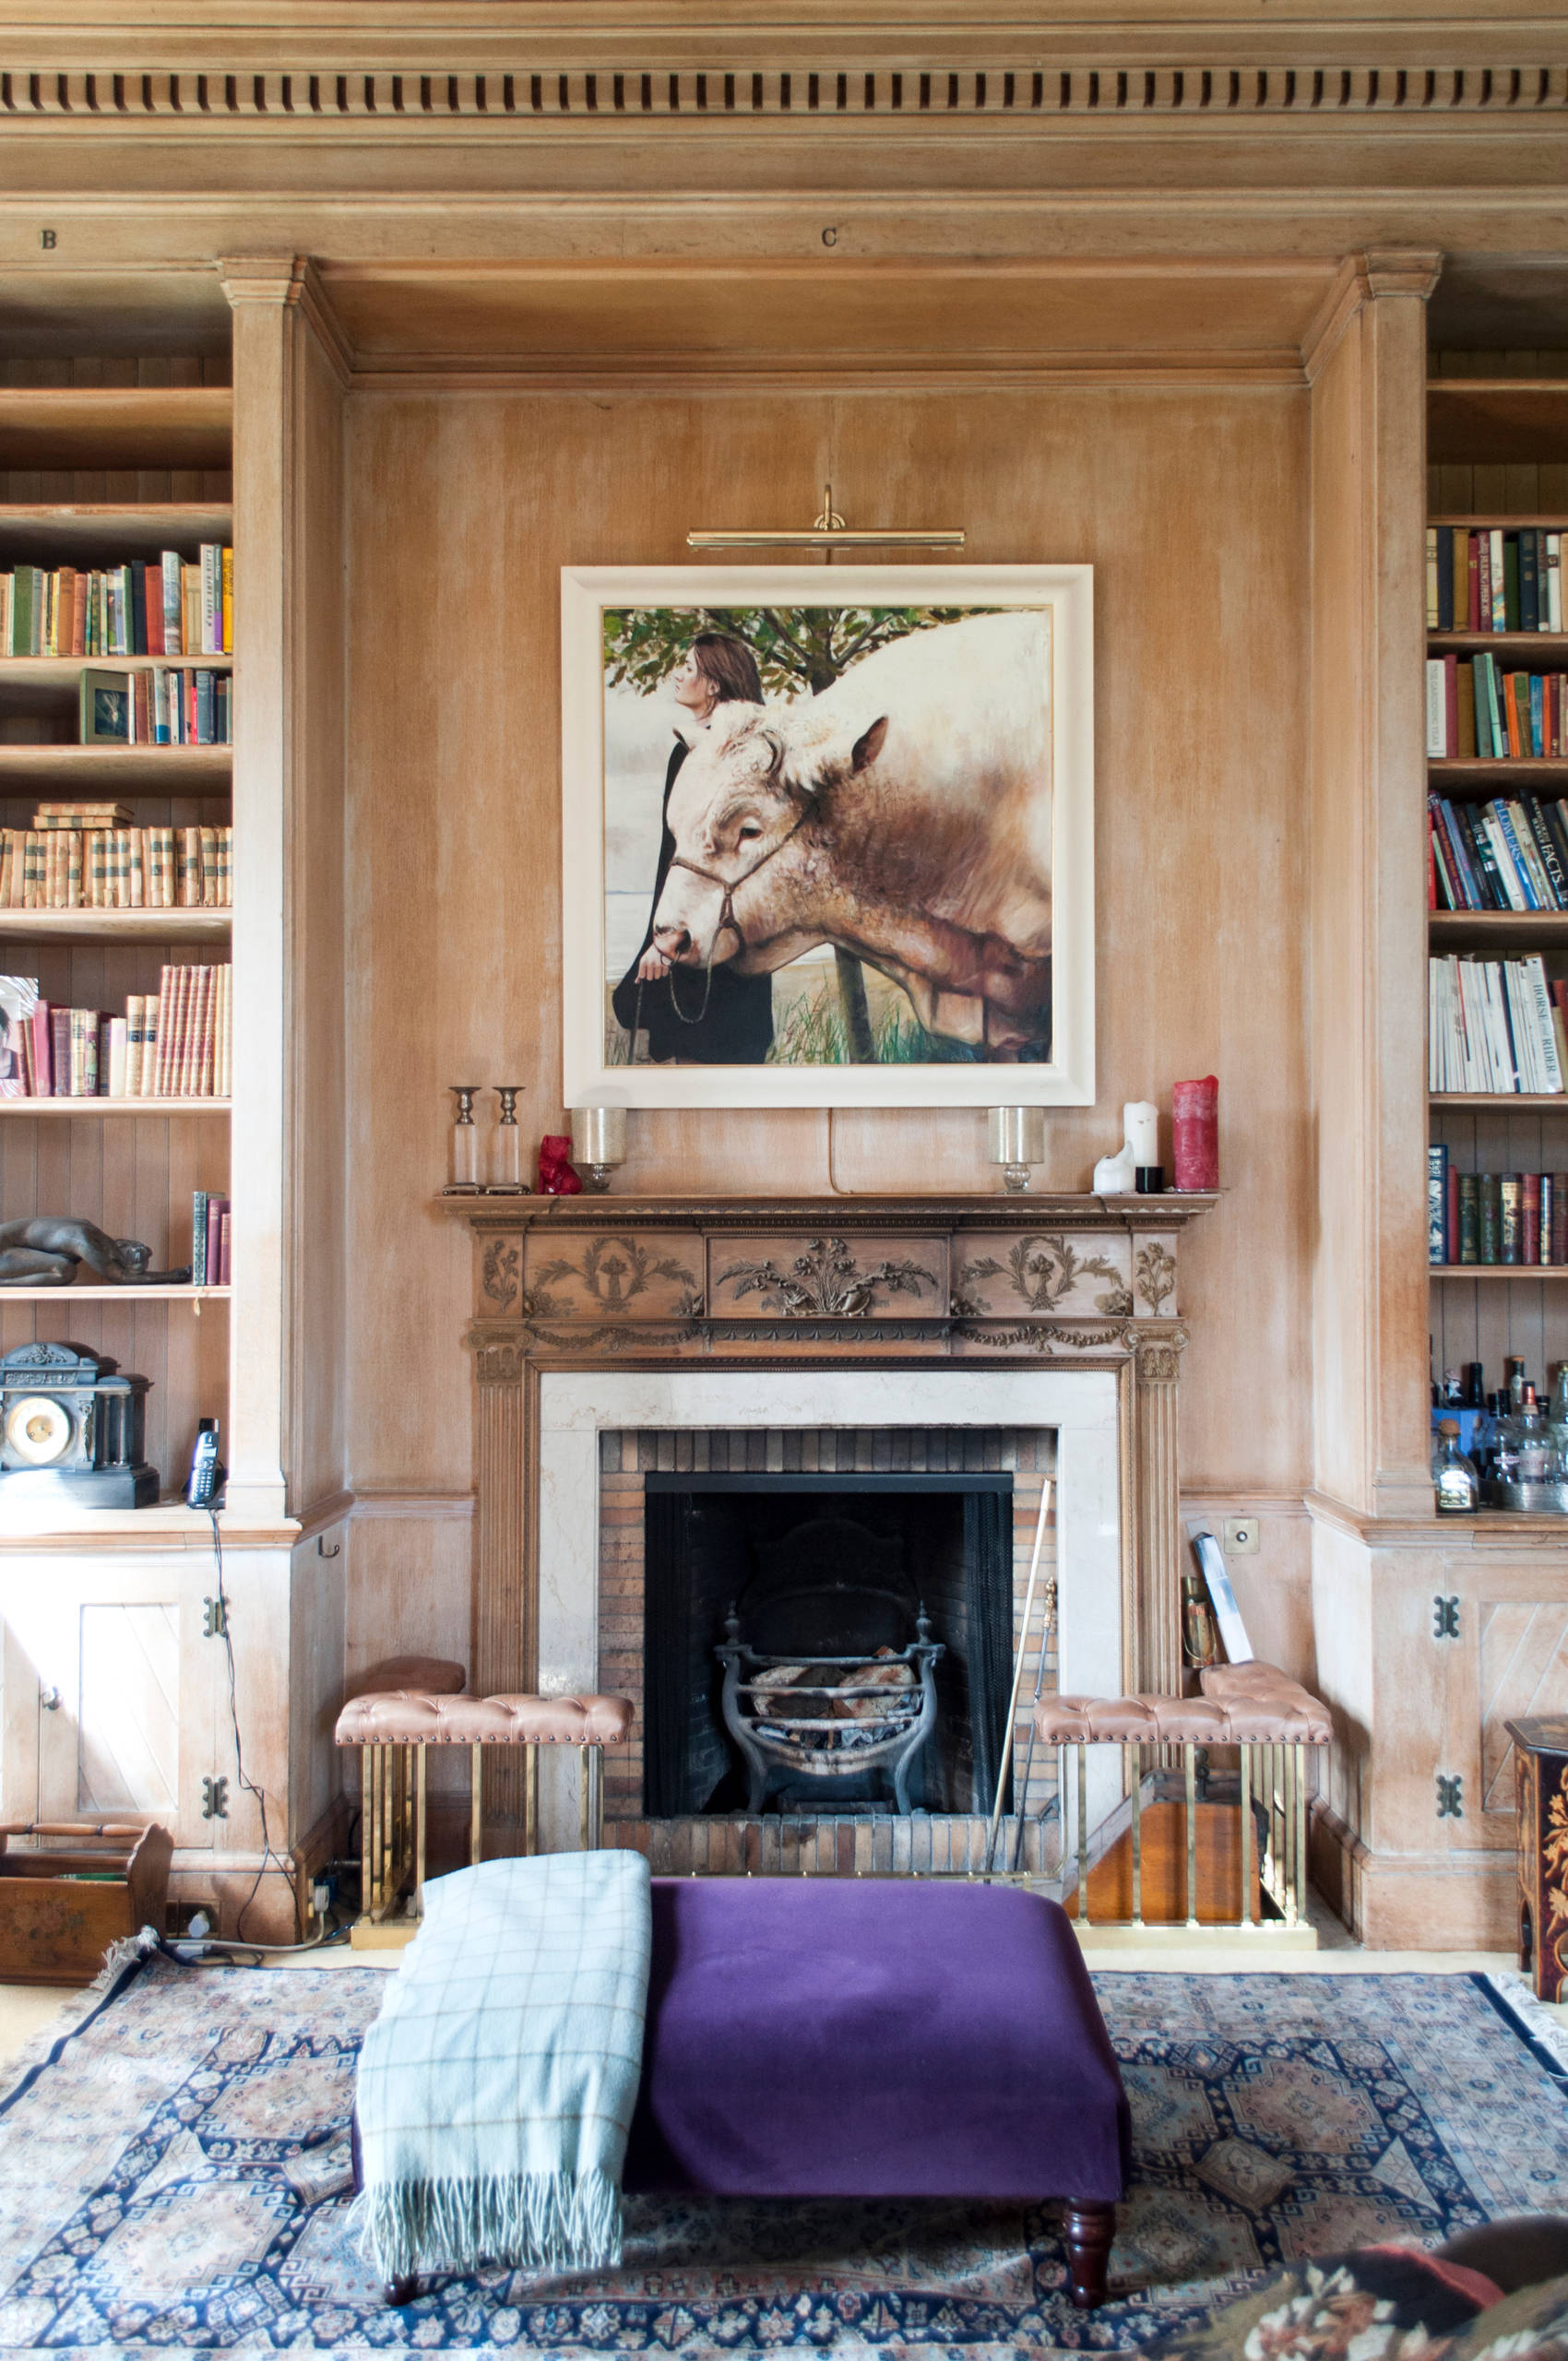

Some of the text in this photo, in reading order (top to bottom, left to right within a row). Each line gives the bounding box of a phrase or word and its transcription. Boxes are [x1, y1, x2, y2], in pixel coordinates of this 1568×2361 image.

[42, 229, 56, 250] B
[821, 227, 837, 247] C
[1494, 800, 1521, 860] FLOWERS
[1540, 843, 1565, 884] FACTS
[1533, 984, 1549, 1021] HORSE
[1542, 1038, 1557, 1072] RIDER
